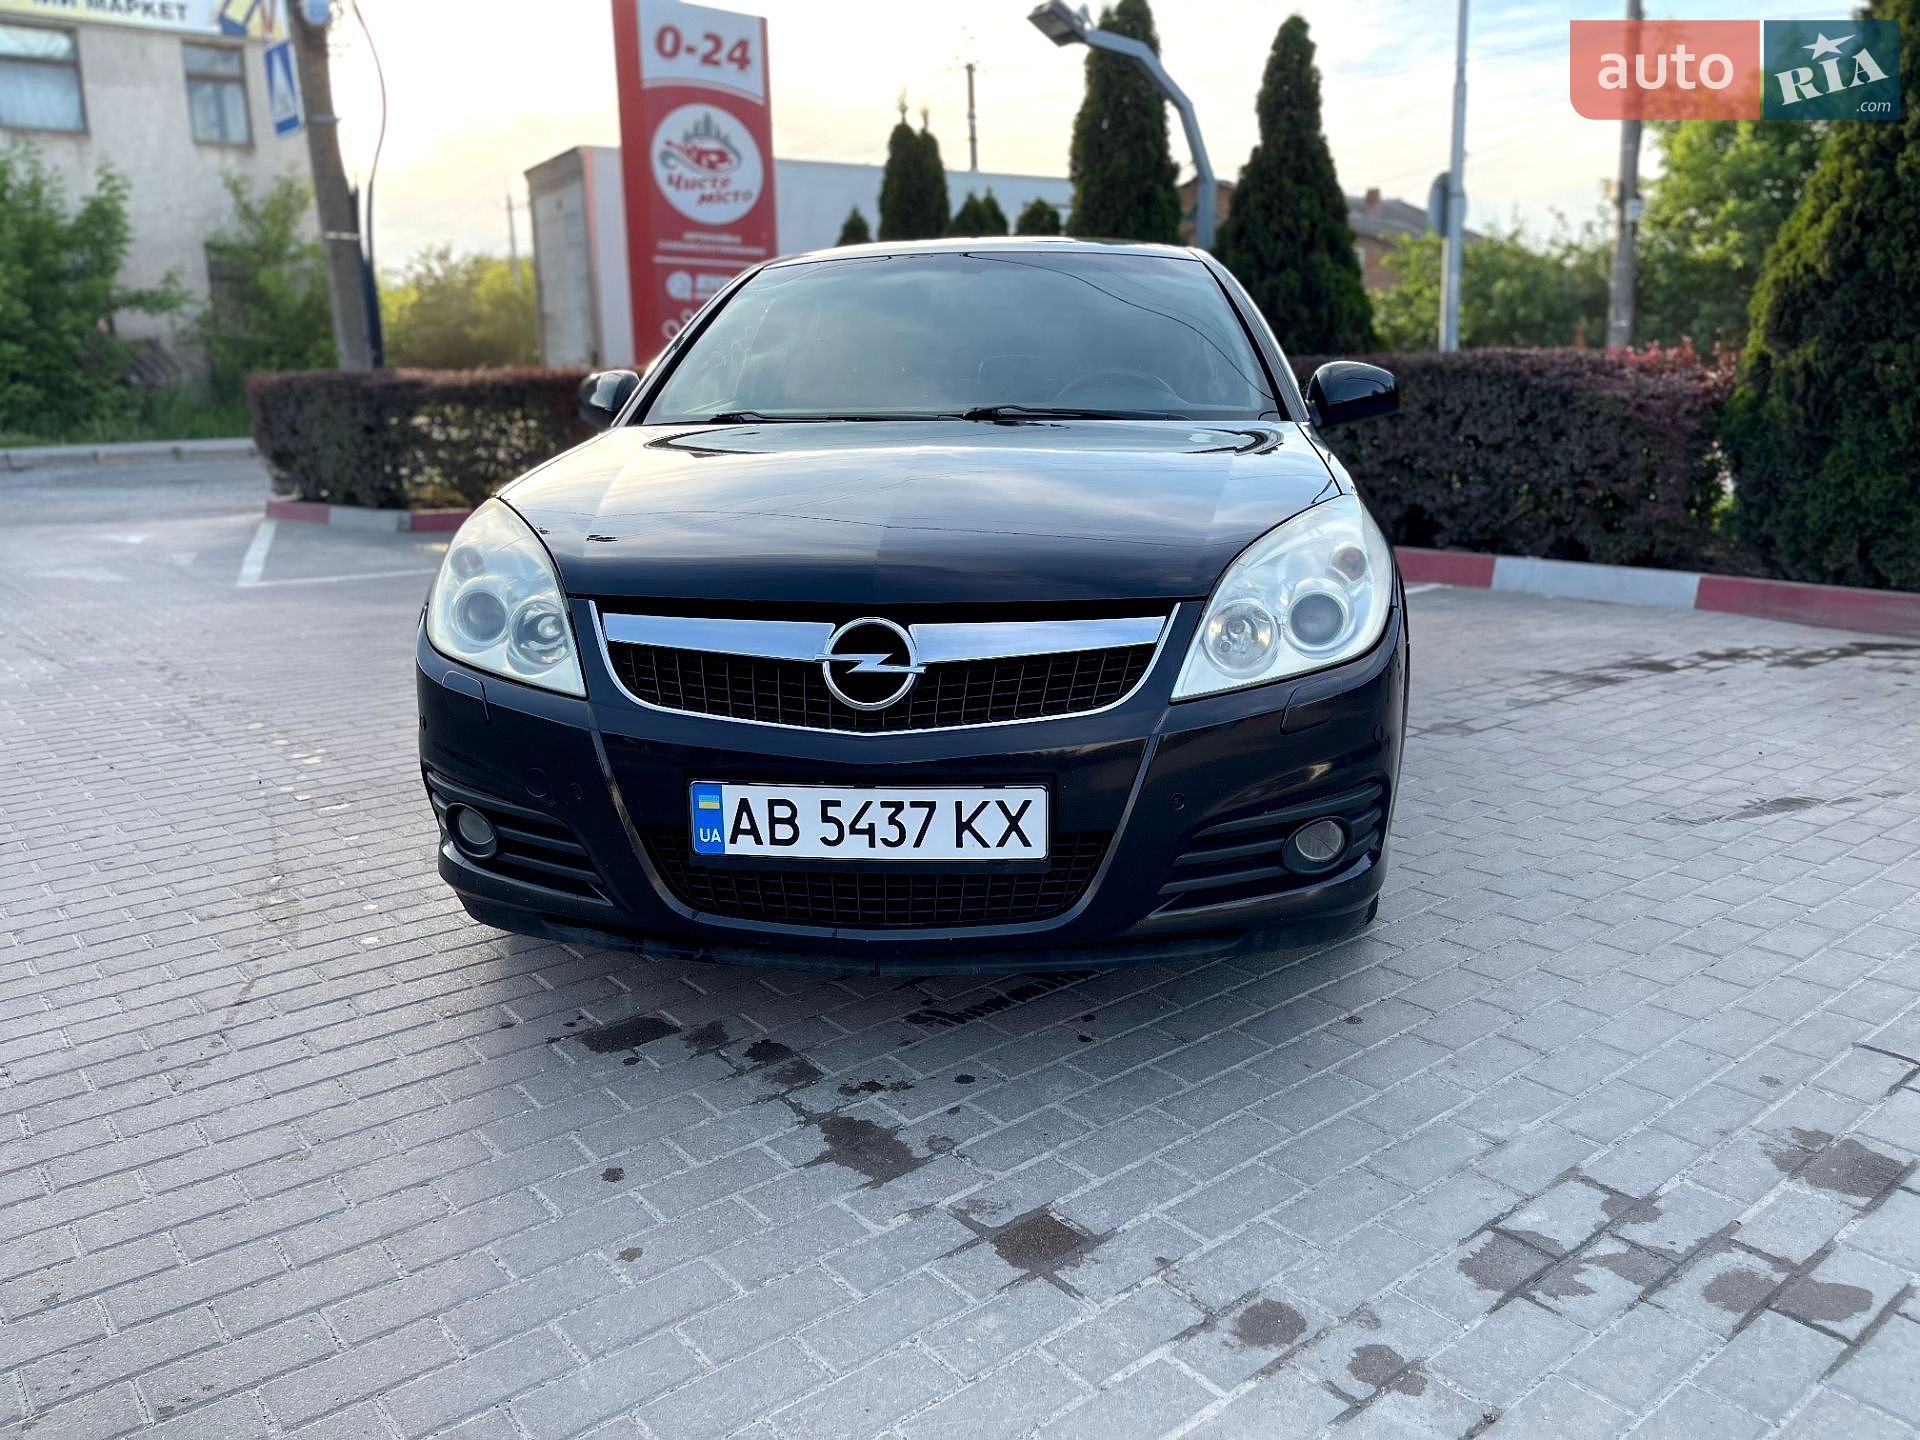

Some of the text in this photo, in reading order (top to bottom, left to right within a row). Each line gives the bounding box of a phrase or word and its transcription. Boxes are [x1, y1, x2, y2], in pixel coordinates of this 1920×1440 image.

[655, 25, 752, 71] 0-24
[699, 828, 722, 843] UA
[729, 798, 1033, 848] AB 5437 KX
